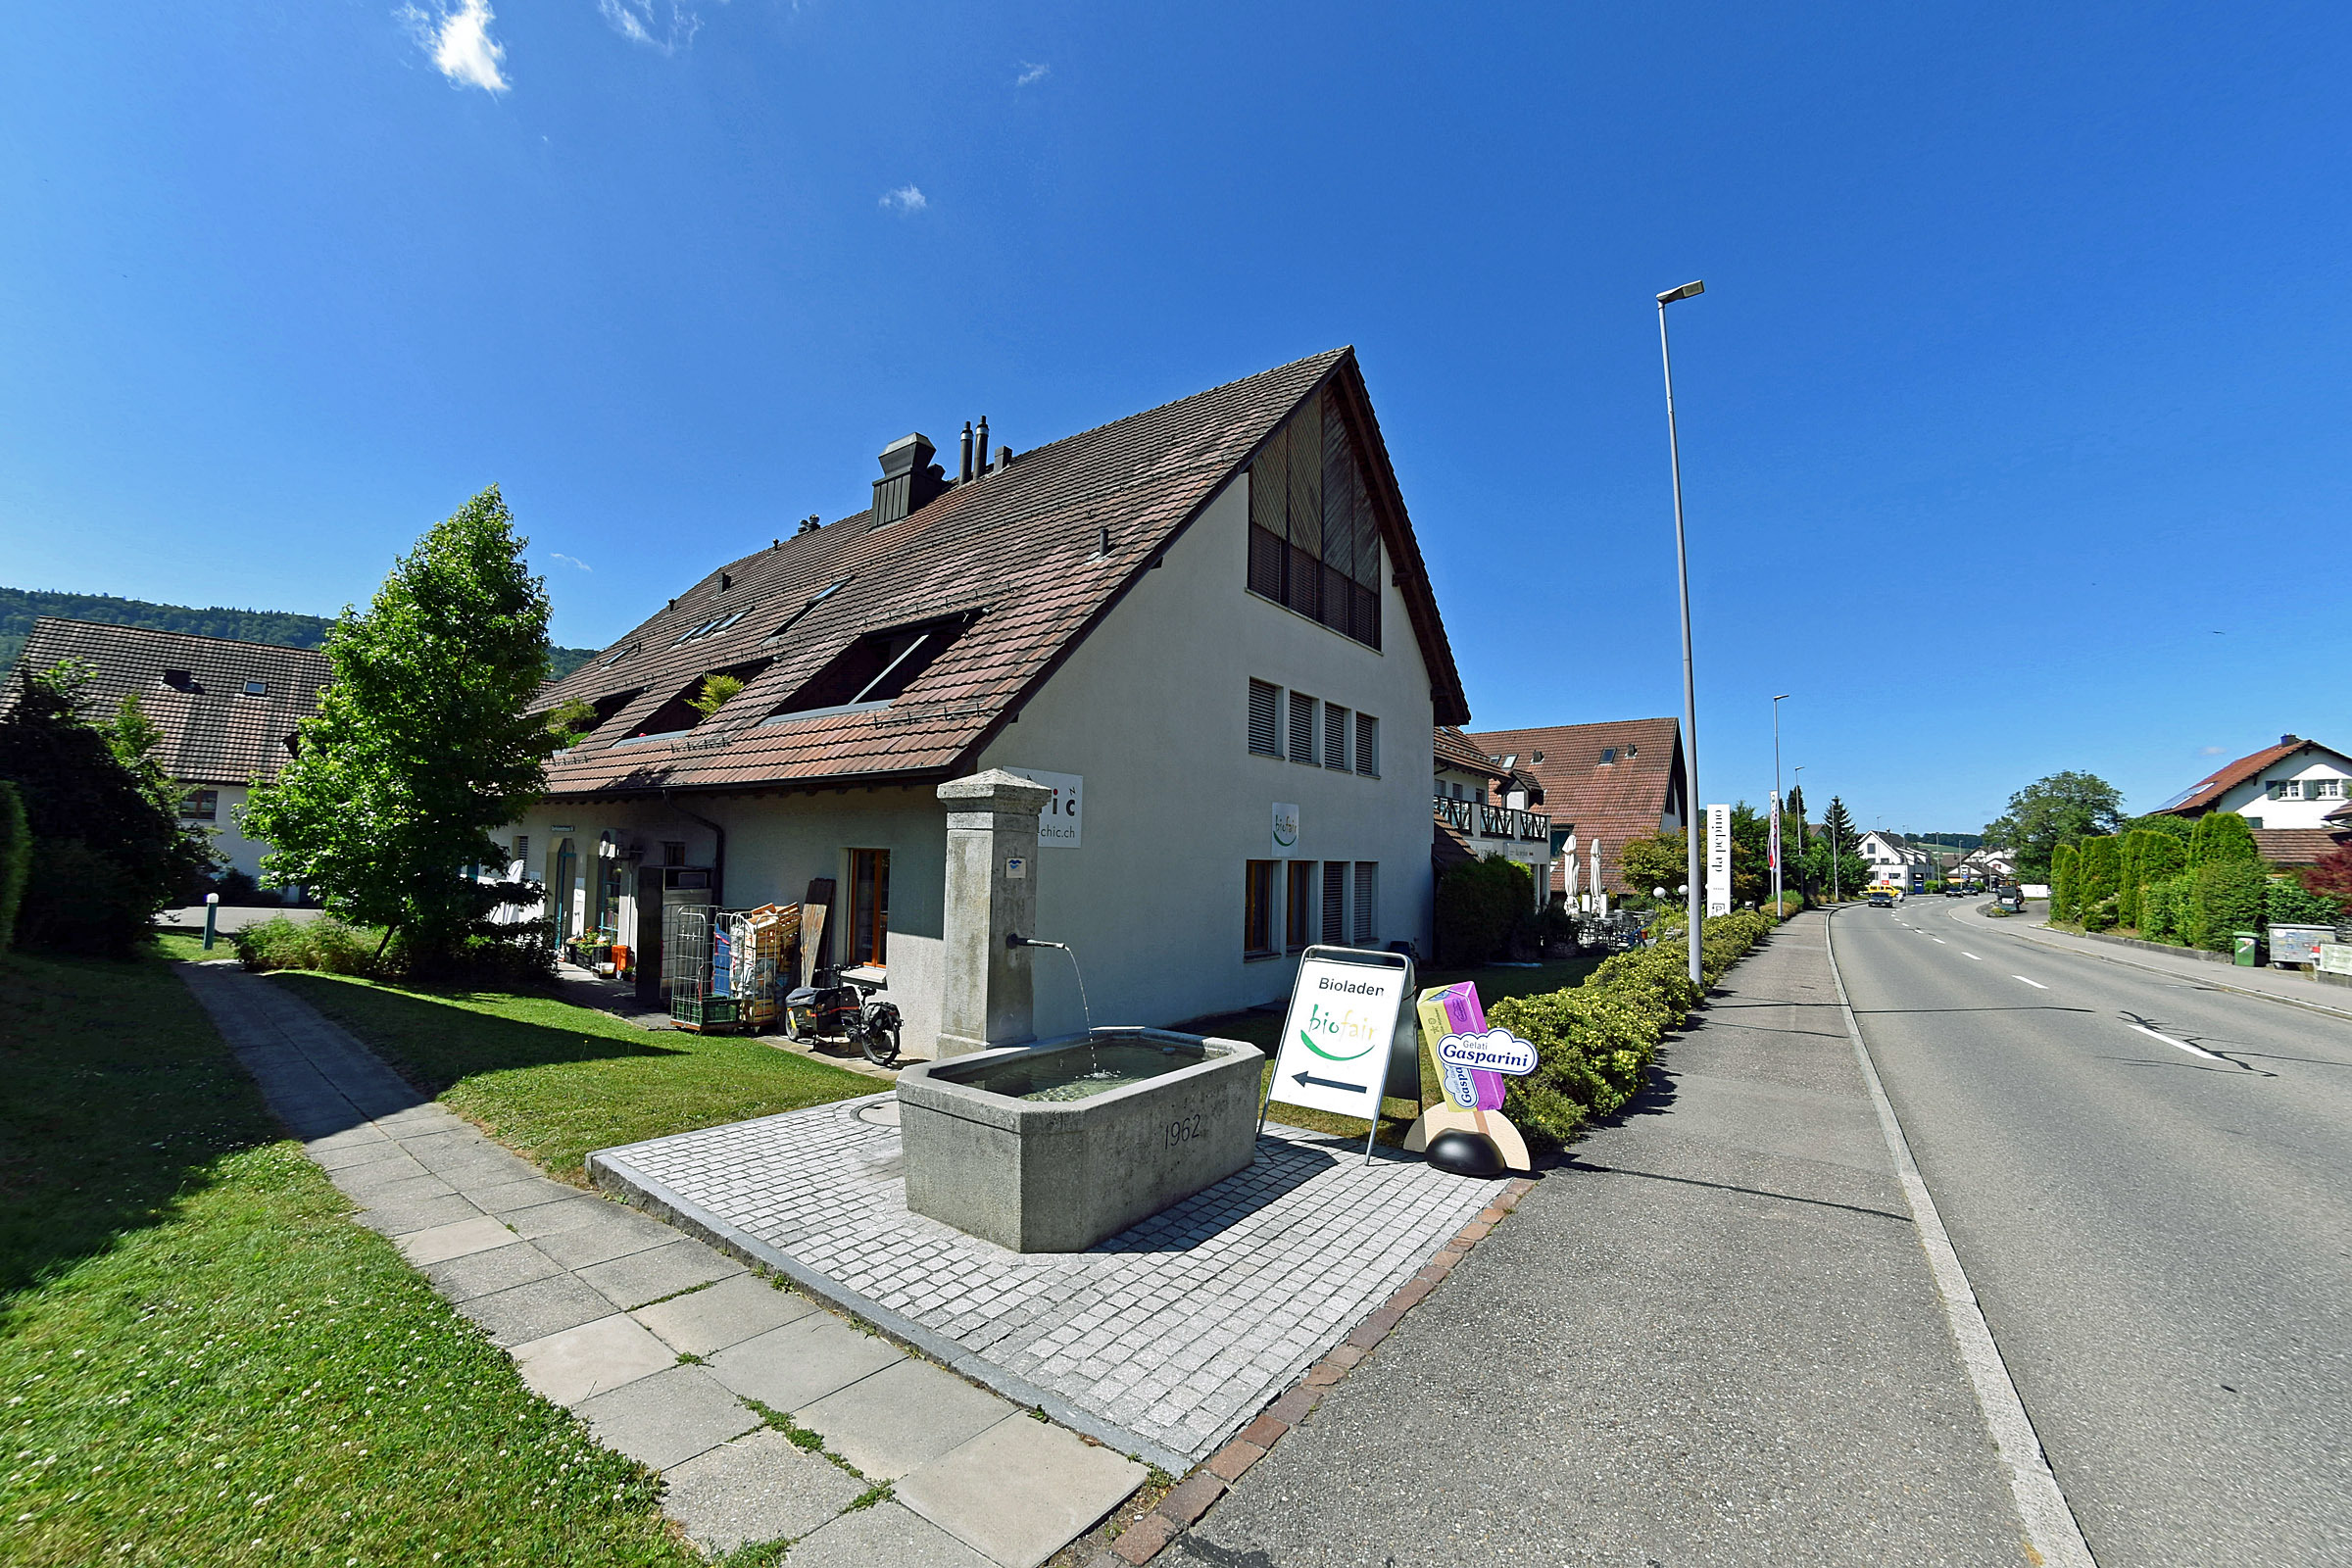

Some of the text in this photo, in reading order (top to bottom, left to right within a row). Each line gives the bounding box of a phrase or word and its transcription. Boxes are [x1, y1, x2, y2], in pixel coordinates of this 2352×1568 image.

[1053, 788, 1076, 816] ic
[1038, 824, 1075, 839] -chic.ch
[1275, 814, 1298, 834] biofair
[1711, 809, 1727, 853] pepino
[1711, 855, 1723, 872] da
[1318, 977, 1385, 997] Bioladen
[1443, 1044, 1529, 1067] Gasparini
[1462, 1040, 1489, 1051] Gelati
[1455, 1067, 1472, 1103] Gaspa
[1164, 1113, 1201, 1151] 1962
